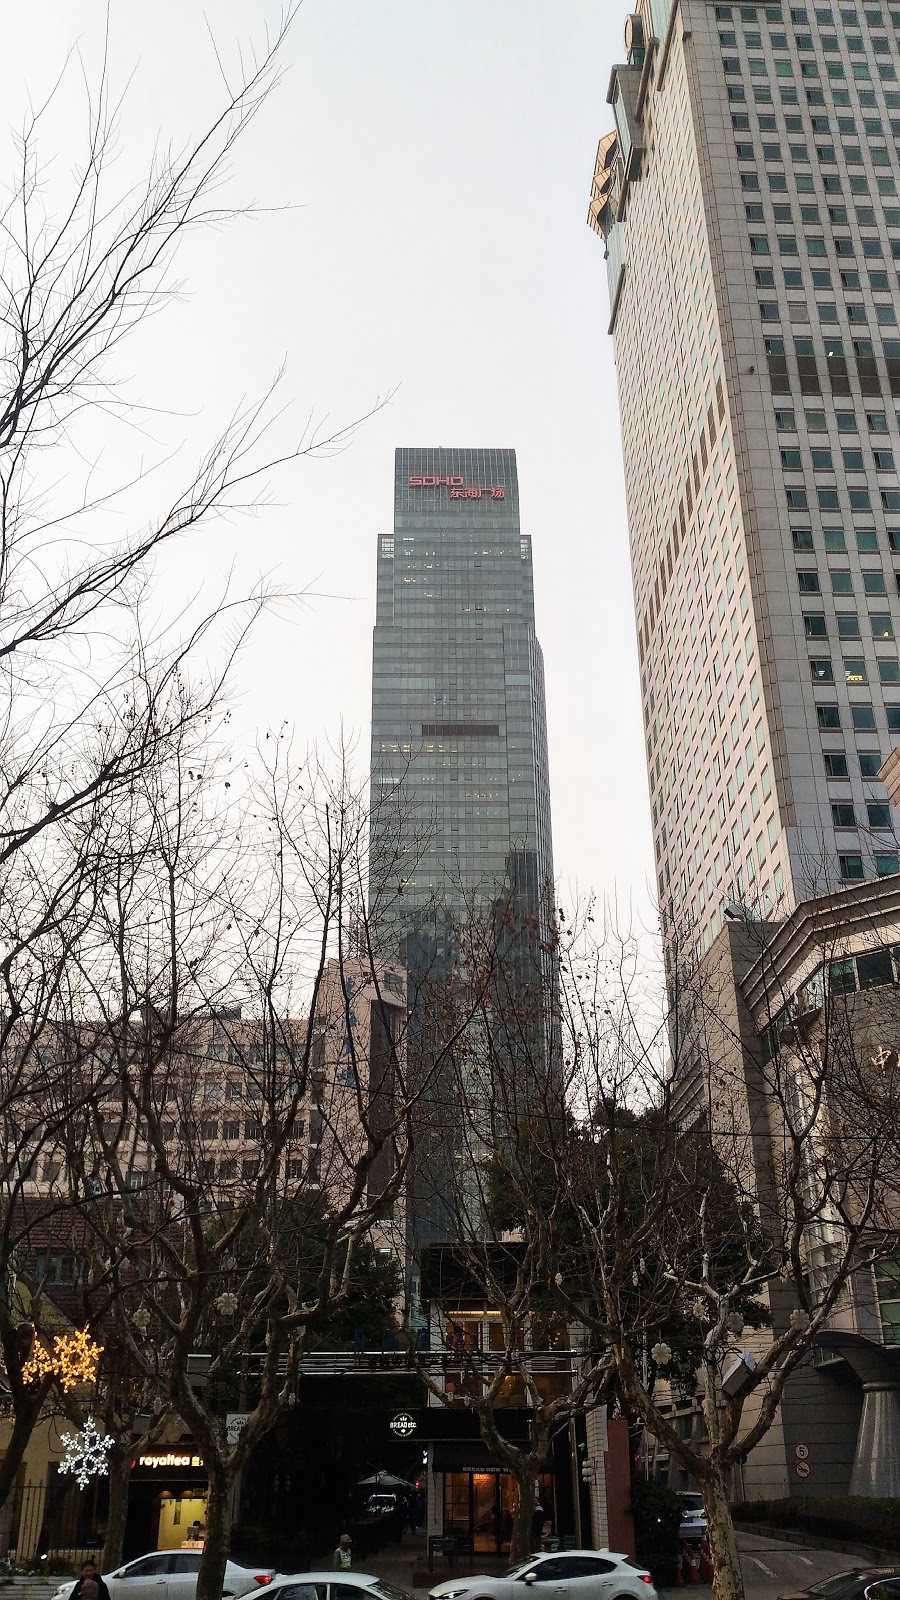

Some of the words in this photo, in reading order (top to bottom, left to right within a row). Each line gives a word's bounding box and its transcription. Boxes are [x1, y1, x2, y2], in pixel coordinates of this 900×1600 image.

[409, 476, 464, 485] SOHO
[450, 487, 506, 498] 东海广场
[800, 1446, 805, 1456] 5
[139, 1453, 191, 1468] royaltea
